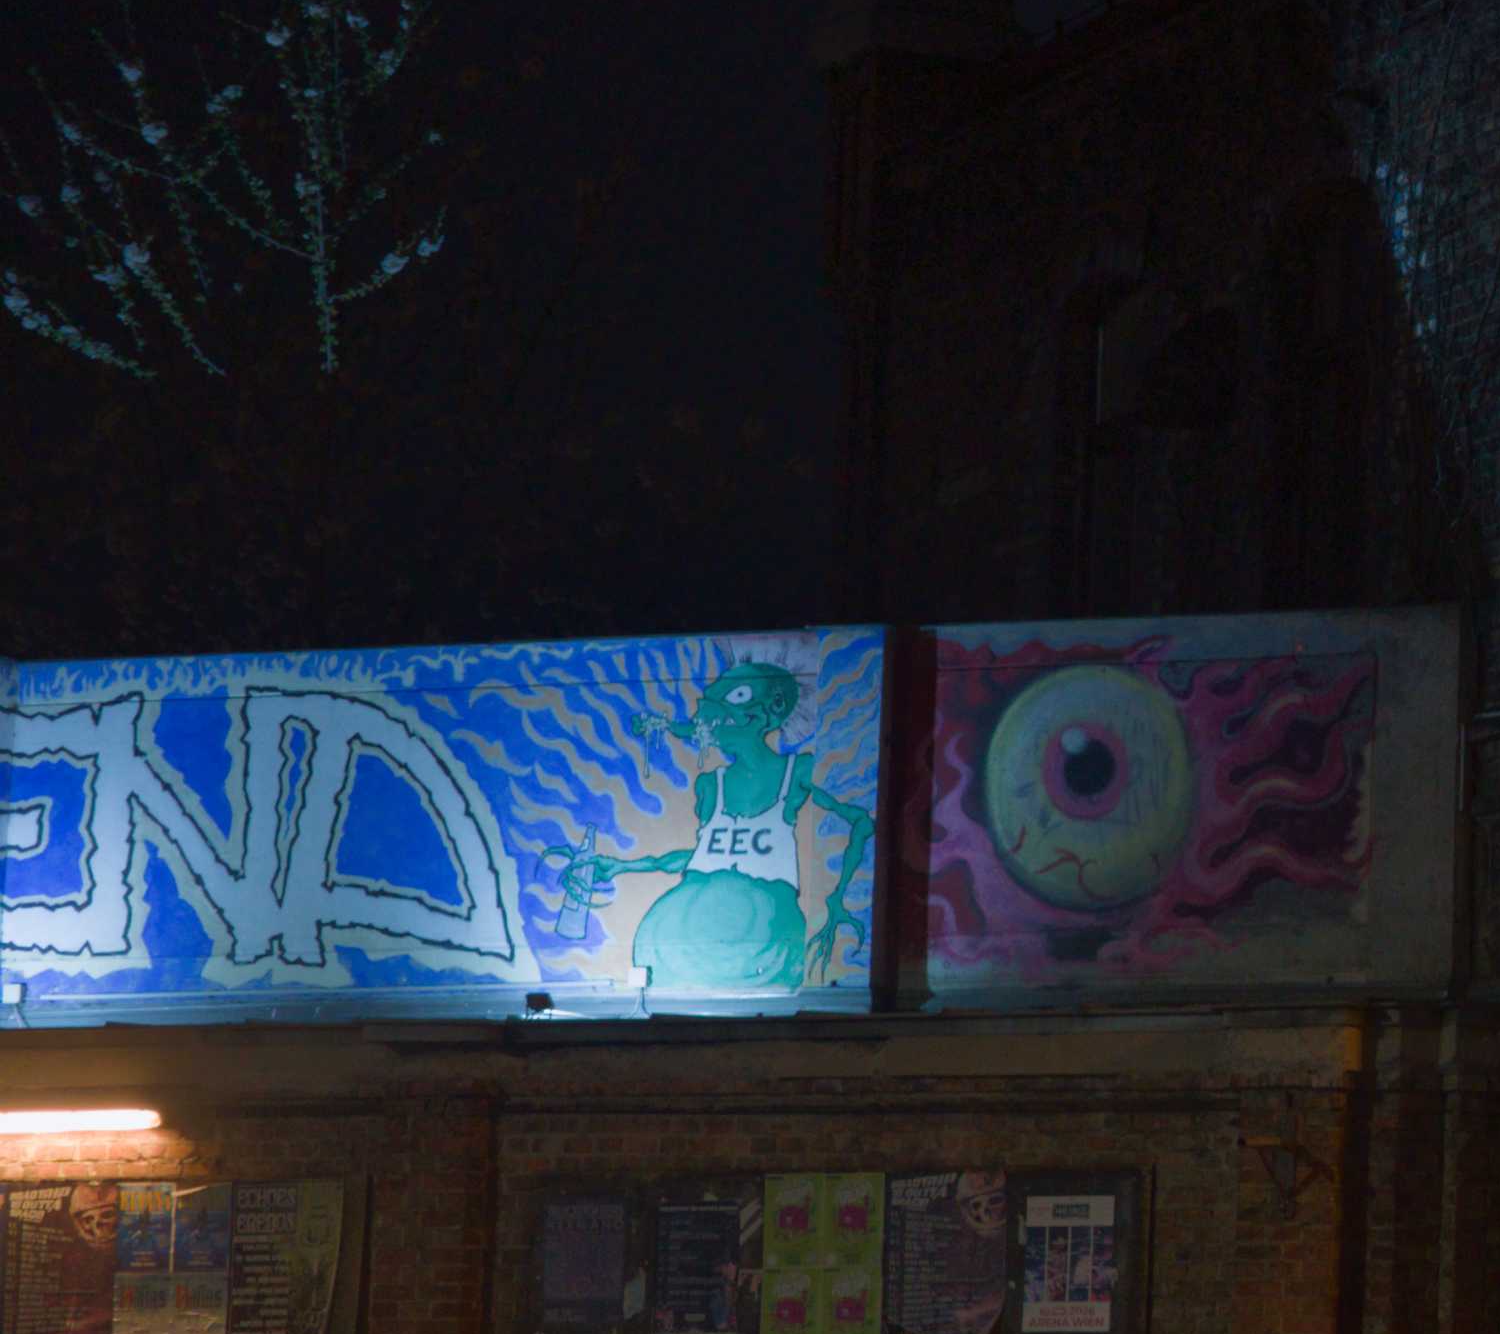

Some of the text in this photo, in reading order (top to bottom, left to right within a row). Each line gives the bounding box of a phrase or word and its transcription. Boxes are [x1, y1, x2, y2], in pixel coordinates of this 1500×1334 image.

[707, 825, 774, 857] EEC
[1029, 1316, 1104, 1328] ARENA WIEN
